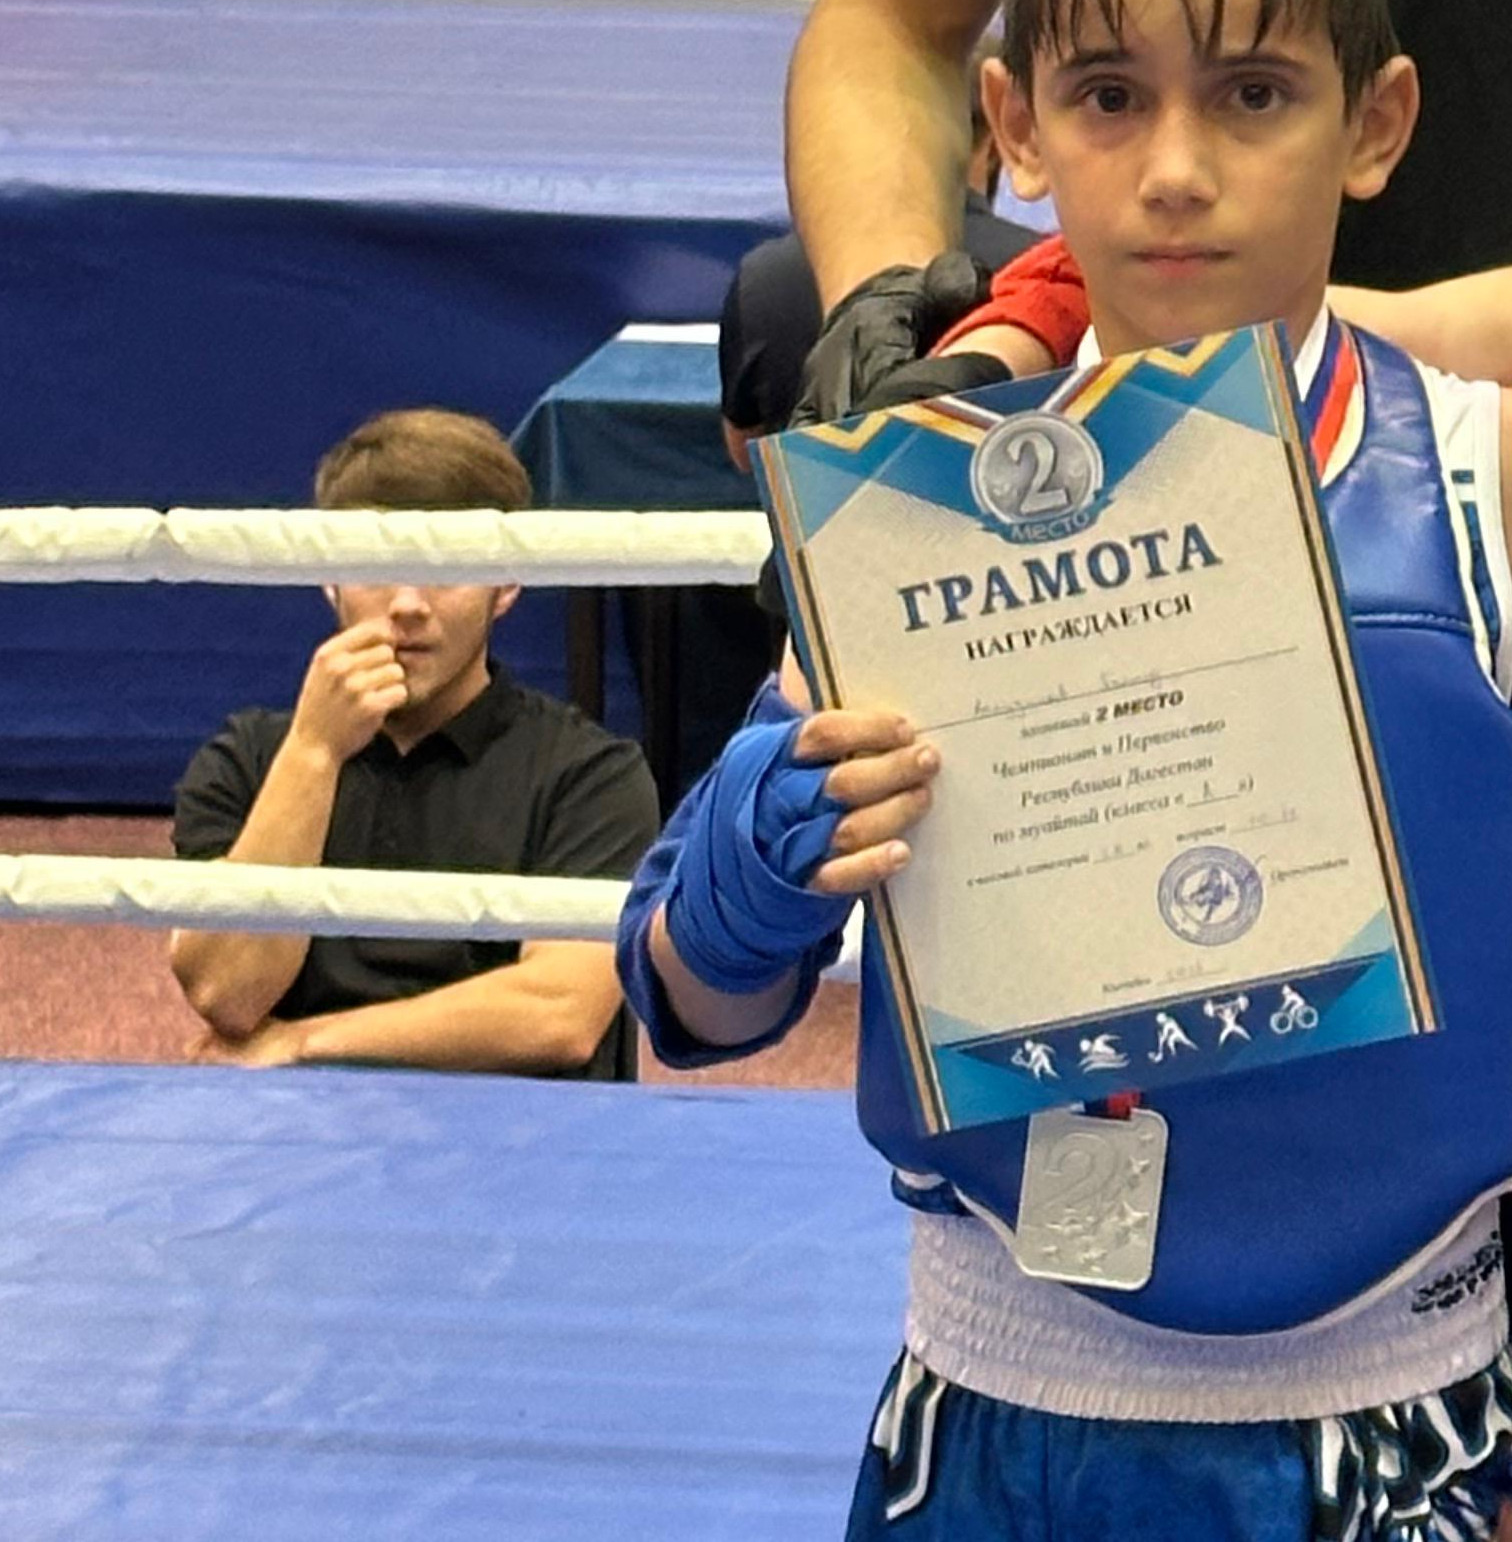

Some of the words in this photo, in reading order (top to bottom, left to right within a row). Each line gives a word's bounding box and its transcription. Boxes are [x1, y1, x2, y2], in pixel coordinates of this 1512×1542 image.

[1008, 429, 1070, 514] 2
[898, 521, 1224, 634] ГРАМОТА
[964, 593, 1194, 662] НАГРАЖДАЕТСЯ
[1095, 704, 1110, 724] 2
[1113, 689, 1185, 722] МЕСТО
